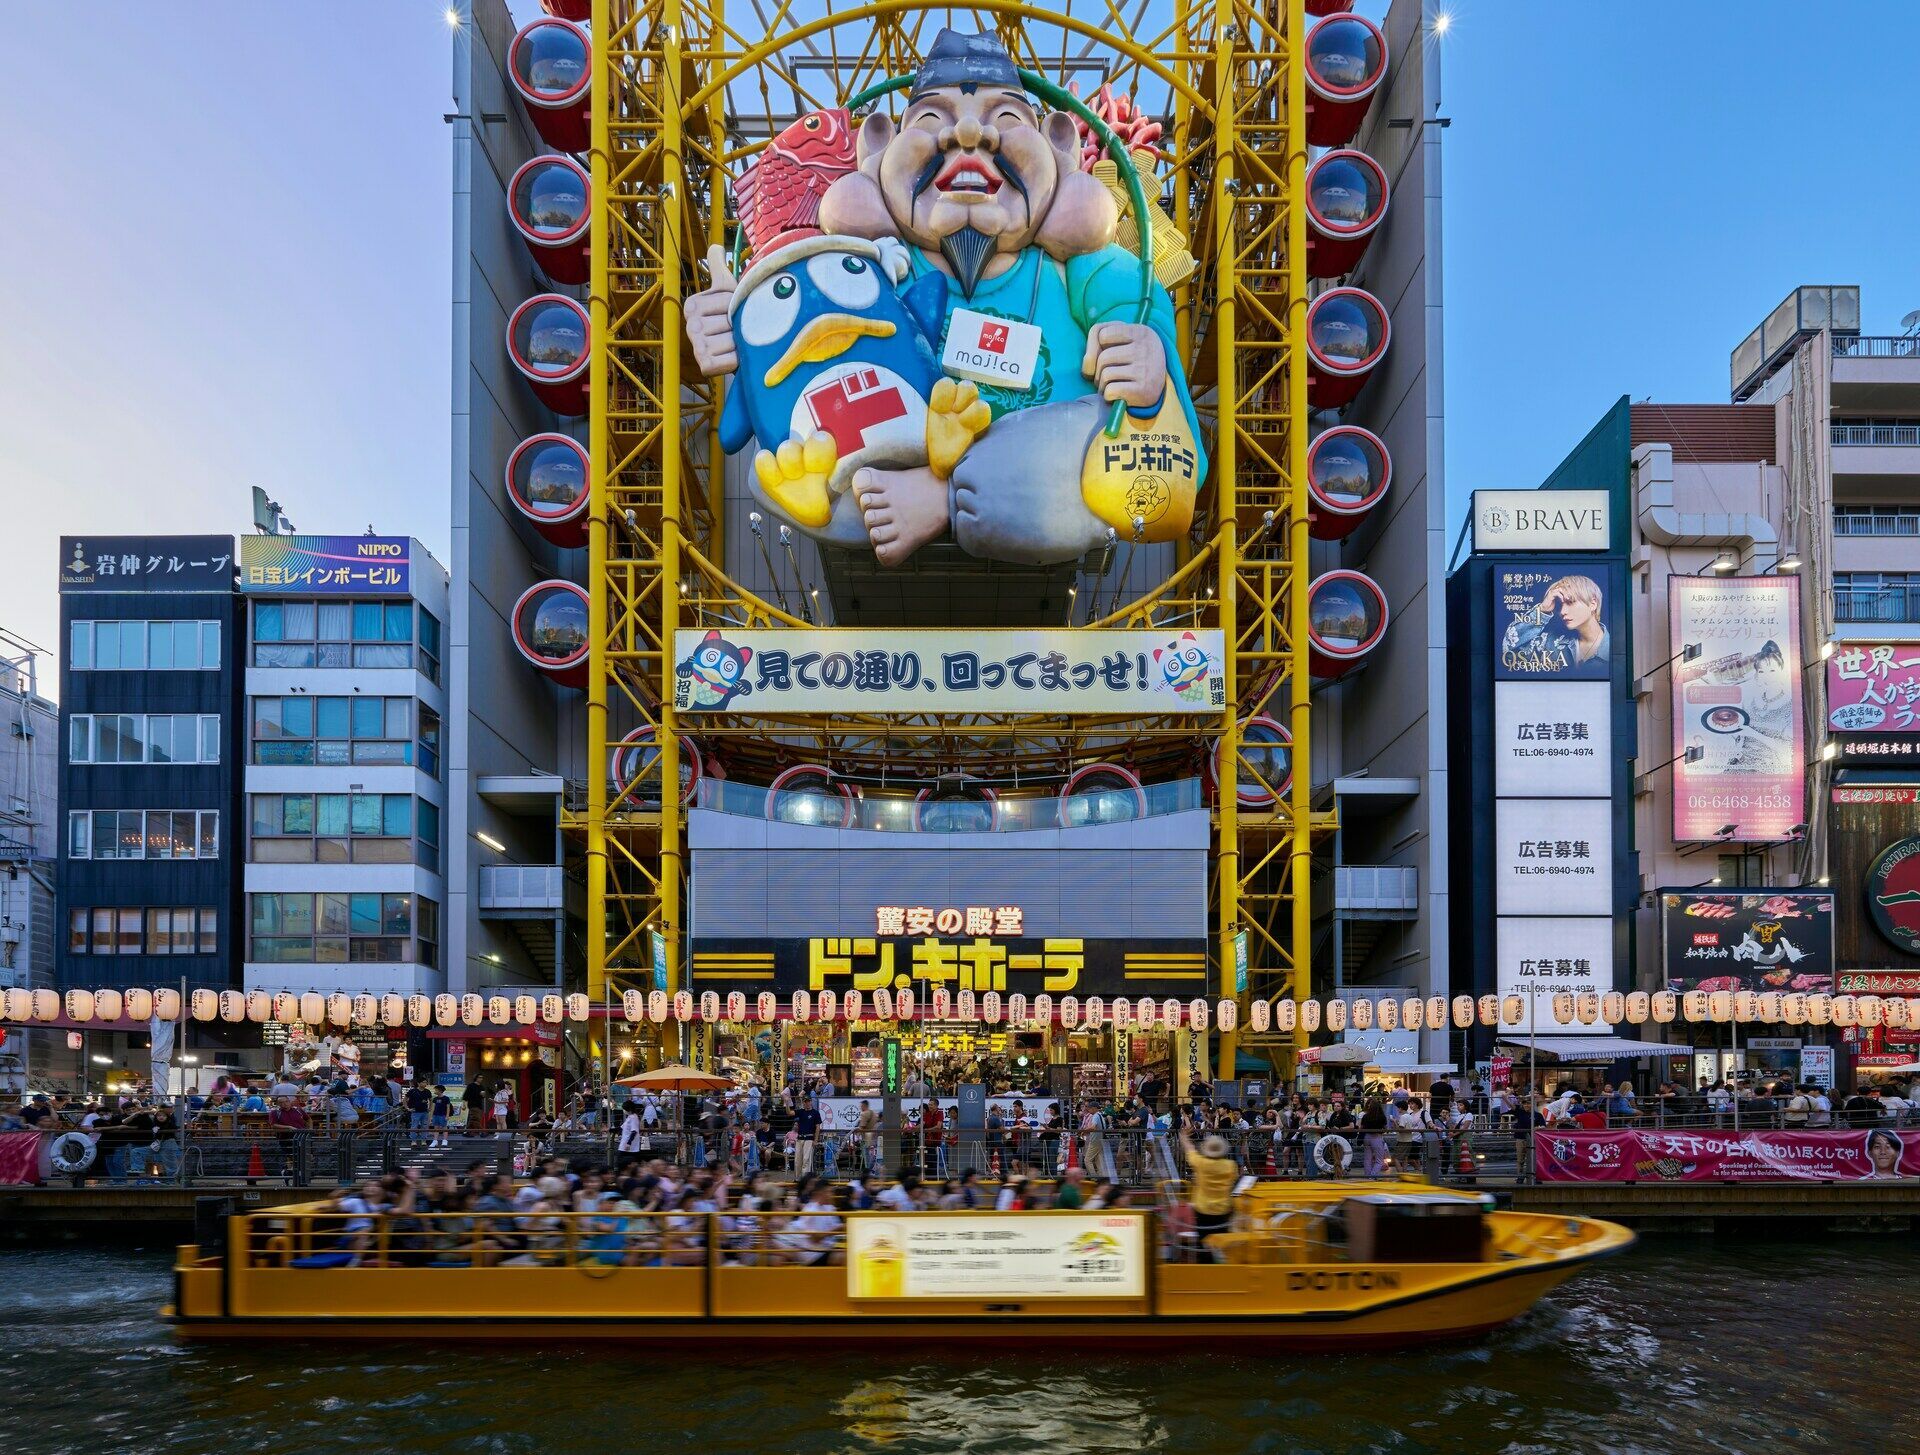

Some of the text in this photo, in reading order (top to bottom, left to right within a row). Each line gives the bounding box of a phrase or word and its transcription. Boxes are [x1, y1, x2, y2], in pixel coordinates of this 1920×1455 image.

[1515, 509, 1603, 531] BRAVE
[357, 544, 402, 556] NIPPO
[96, 554, 231, 576] 岩伸グループ
[61, 573, 95, 583] IWASHIN
[250, 566, 402, 585] 日宝レインボービル
[1514, 606, 1544, 627] No.1
[1690, 604, 1778, 616] マダムシンコ
[1501, 649, 1568, 668] OSAKA
[675, 679, 691, 708] 招福
[1209, 676, 1226, 706] 開運
[1517, 722, 1589, 741] 広告募集
[1512, 747, 1594, 757] TEL:06-6940-4974
[1688, 795, 1792, 809] 06-6468-4538
[1518, 840, 1590, 859] 広告募集
[1513, 865, 1595, 875] TEL:06-6940-4974
[876, 905, 1024, 937] 驚安の殿堂
[1519, 958, 1591, 978] 広告募集
[1514, 983, 1596, 994] TEL06-6940-4974
[1719, 1163, 1747, 1171] Speaking
